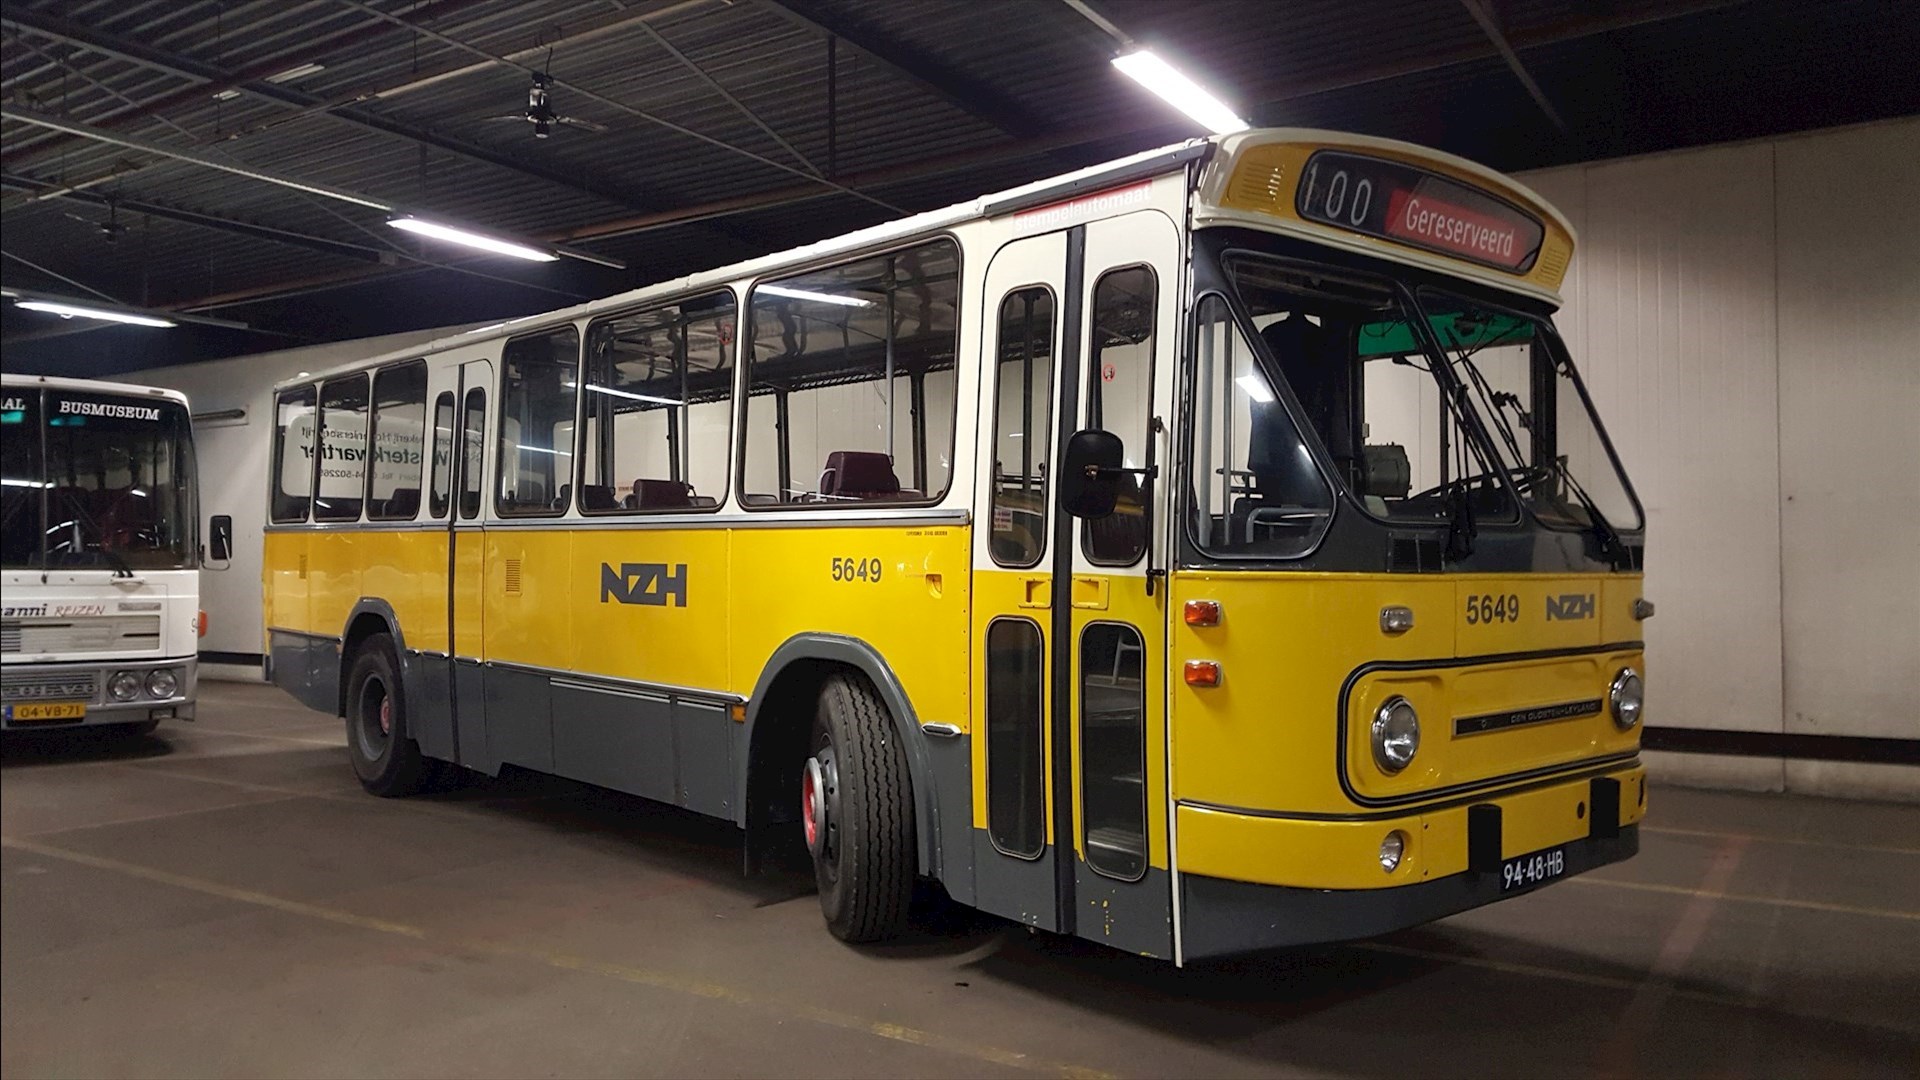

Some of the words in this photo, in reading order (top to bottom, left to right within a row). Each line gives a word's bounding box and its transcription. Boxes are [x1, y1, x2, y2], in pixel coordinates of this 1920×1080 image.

[1014, 185, 1151, 232] stempelautomaat
[1304, 162, 1372, 226] 100
[1405, 199, 1514, 258] Gereserveerd
[59, 400, 160, 421] BUSMUSEUM
[600, 562, 688, 607] NZH
[832, 557, 882, 583] 5649
[1, 603, 48, 616] anni
[55, 605, 105, 617] REIZEN
[1466, 594, 1519, 625] 5649
[1546, 594, 1595, 621] NZH
[20, 705, 80, 718] 04-VB-71
[1503, 850, 1564, 889] 94-48-HB
